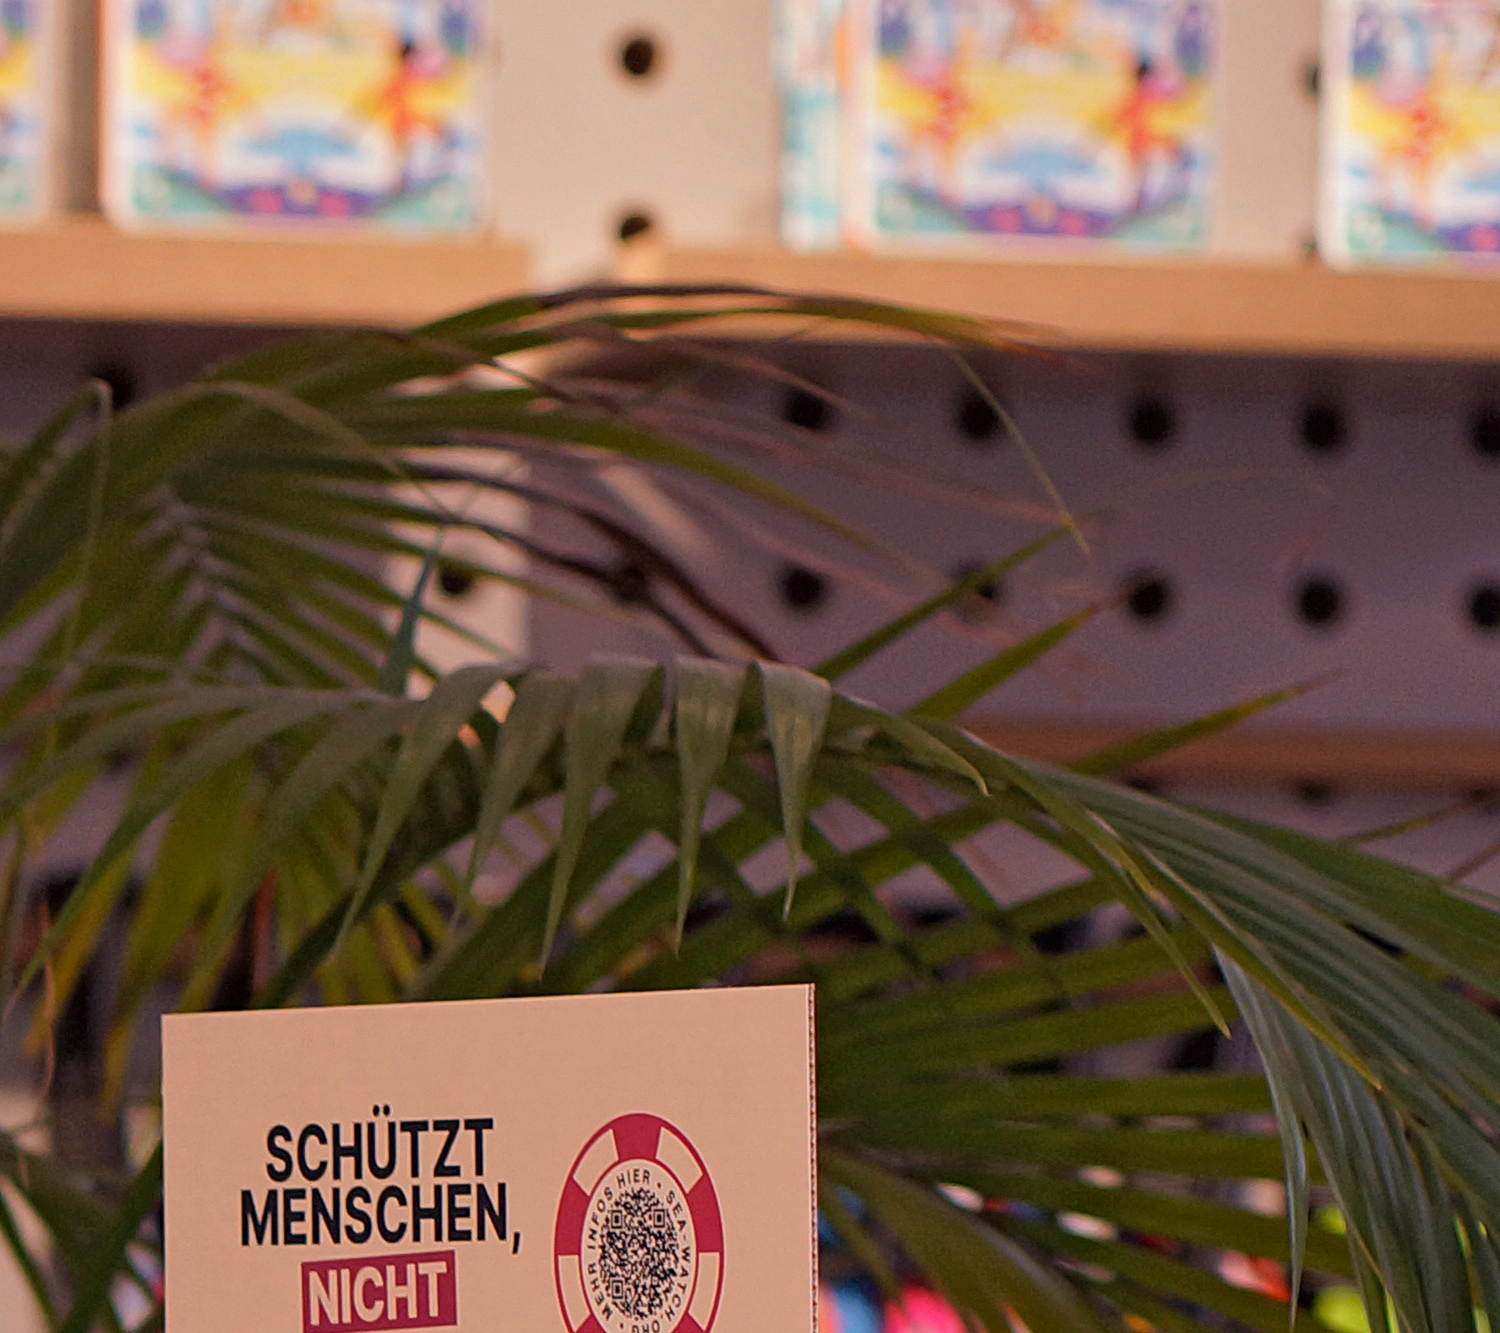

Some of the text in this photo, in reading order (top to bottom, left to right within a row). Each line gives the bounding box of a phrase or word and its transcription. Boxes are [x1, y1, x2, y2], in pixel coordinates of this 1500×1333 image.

[265, 1104, 494, 1182] SCHÜTZT
[617, 1168, 651, 1191] HIER
[240, 1182, 521, 1255] MENSCHEN,
[587, 1187, 613, 1250] INFOS
[308, 1261, 447, 1326] NICHT
[587, 1263, 613, 1321] MEHR
